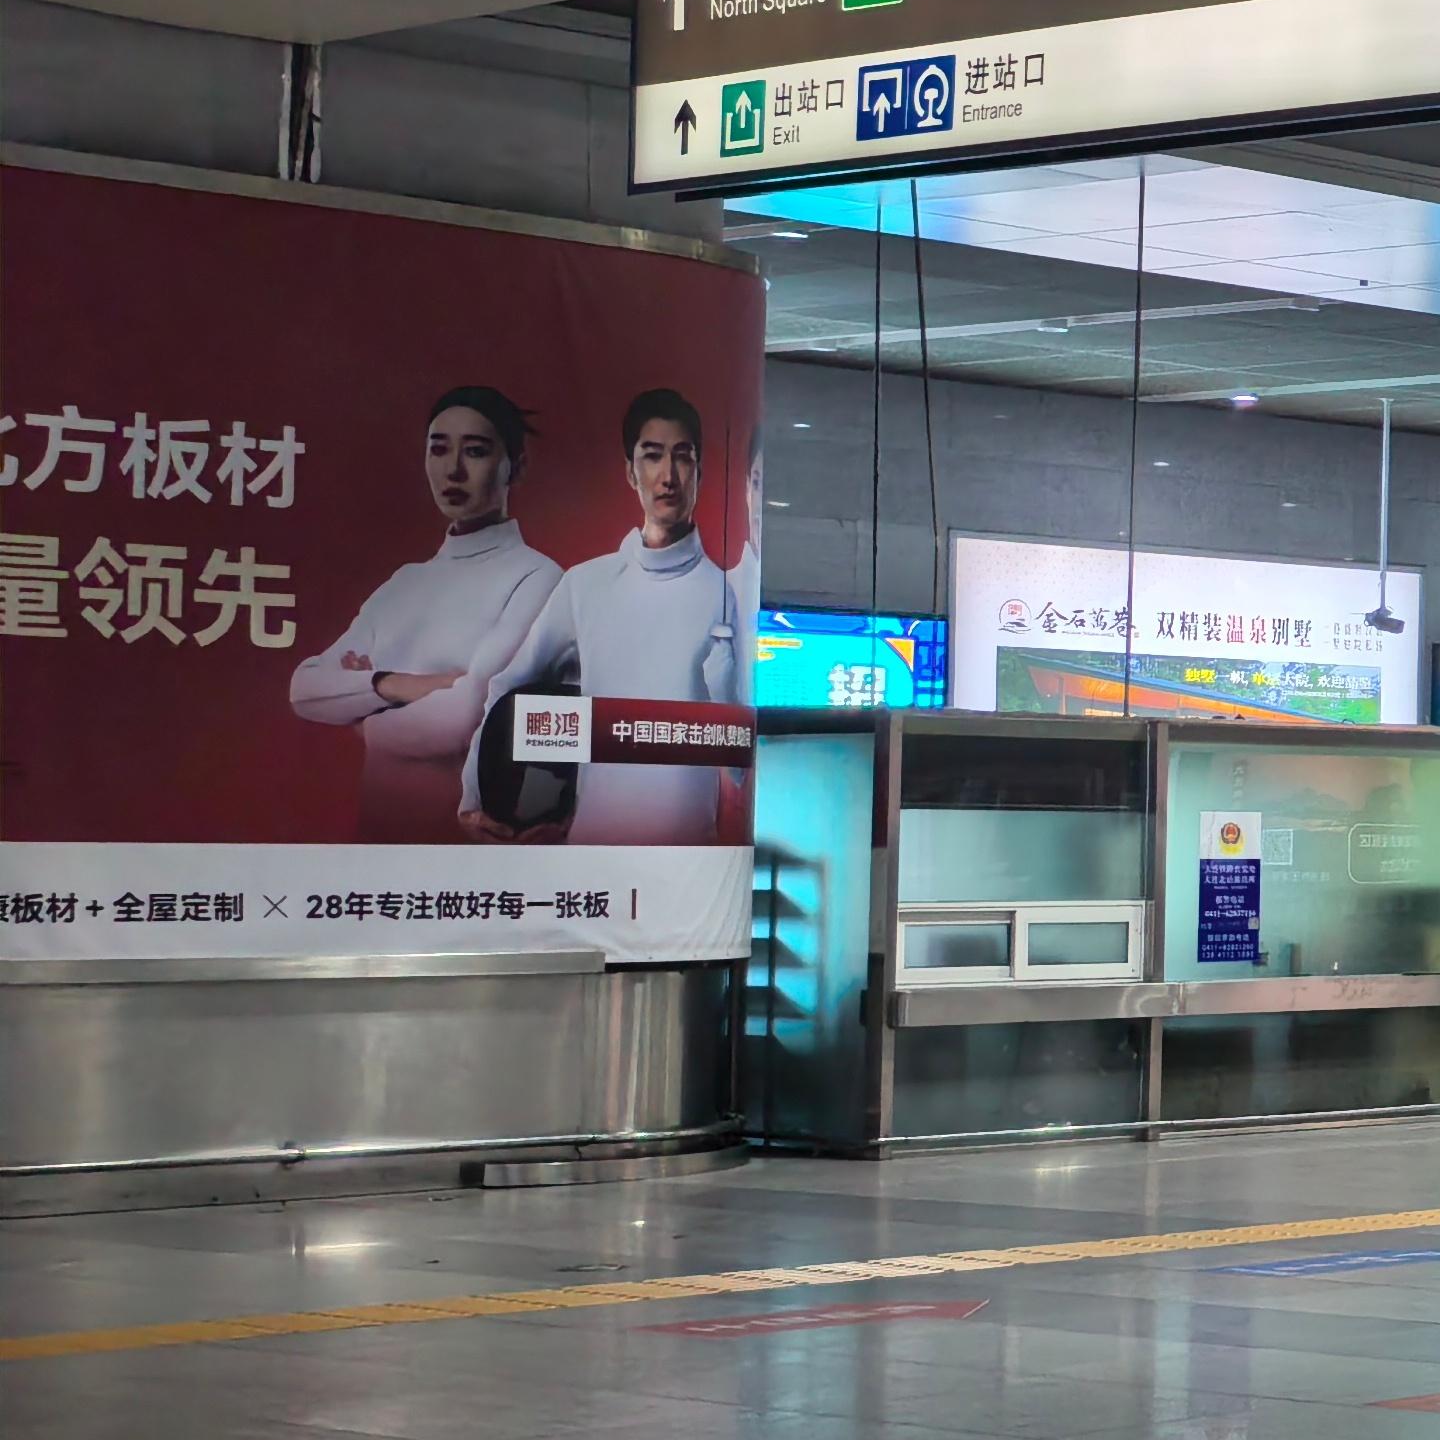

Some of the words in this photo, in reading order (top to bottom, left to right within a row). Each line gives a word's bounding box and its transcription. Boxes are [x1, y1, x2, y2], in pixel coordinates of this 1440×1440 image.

[963, 53, 1046, 96] 进站口
[774, 78, 845, 118] 出站口
[962, 101, 1024, 123] Entrance
[772, 125, 801, 146] Exit
[0, 405, 306, 508] 方板材
[0, 533, 297, 649] 量领先
[1156, 610, 1314, 649] 双精装温泉别墅
[526, 711, 579, 737] 鹏鸿
[525, 739, 579, 748] PENGHONG
[306, 890, 610, 921] 28年专注做好每一张板
